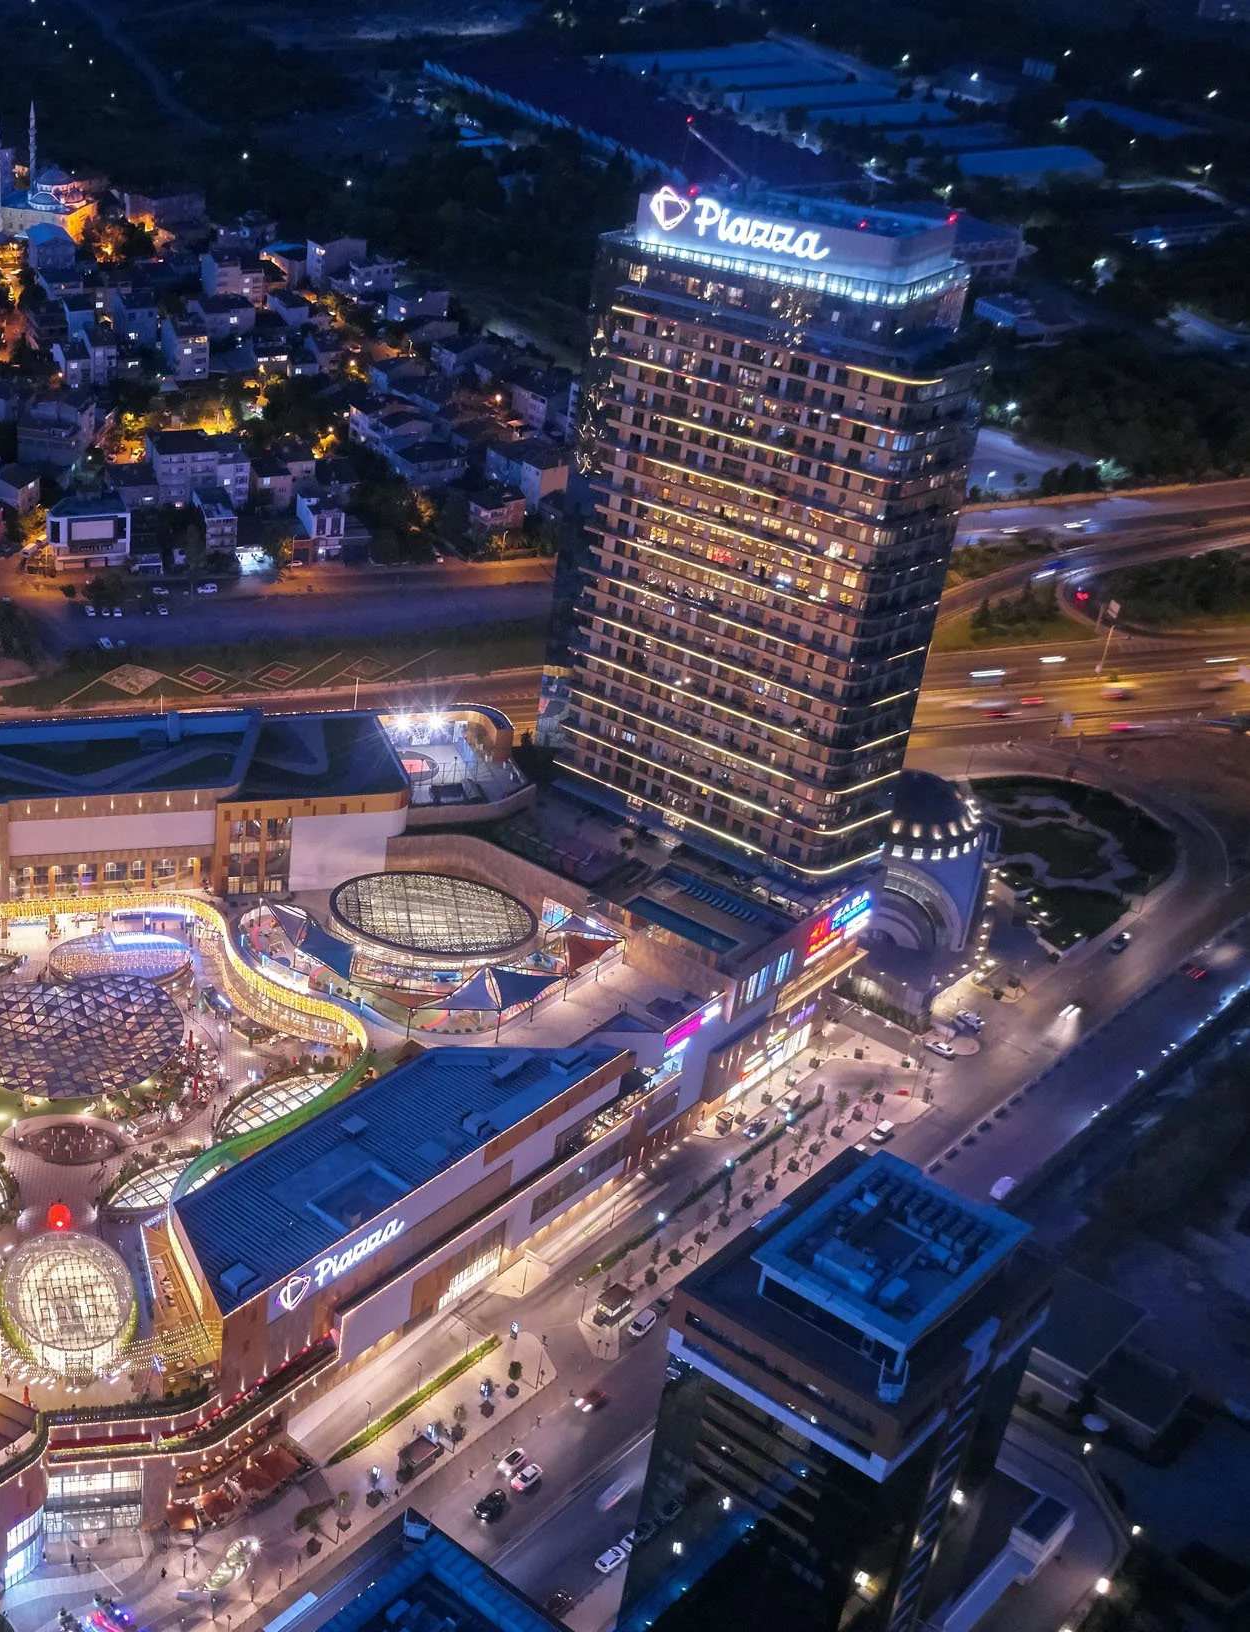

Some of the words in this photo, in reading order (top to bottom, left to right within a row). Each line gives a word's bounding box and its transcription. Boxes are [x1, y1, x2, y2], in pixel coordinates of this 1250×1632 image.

[694, 197, 830, 261] Piazza
[832, 890, 870, 922] ZARA
[314, 1218, 405, 1287] Piazza
